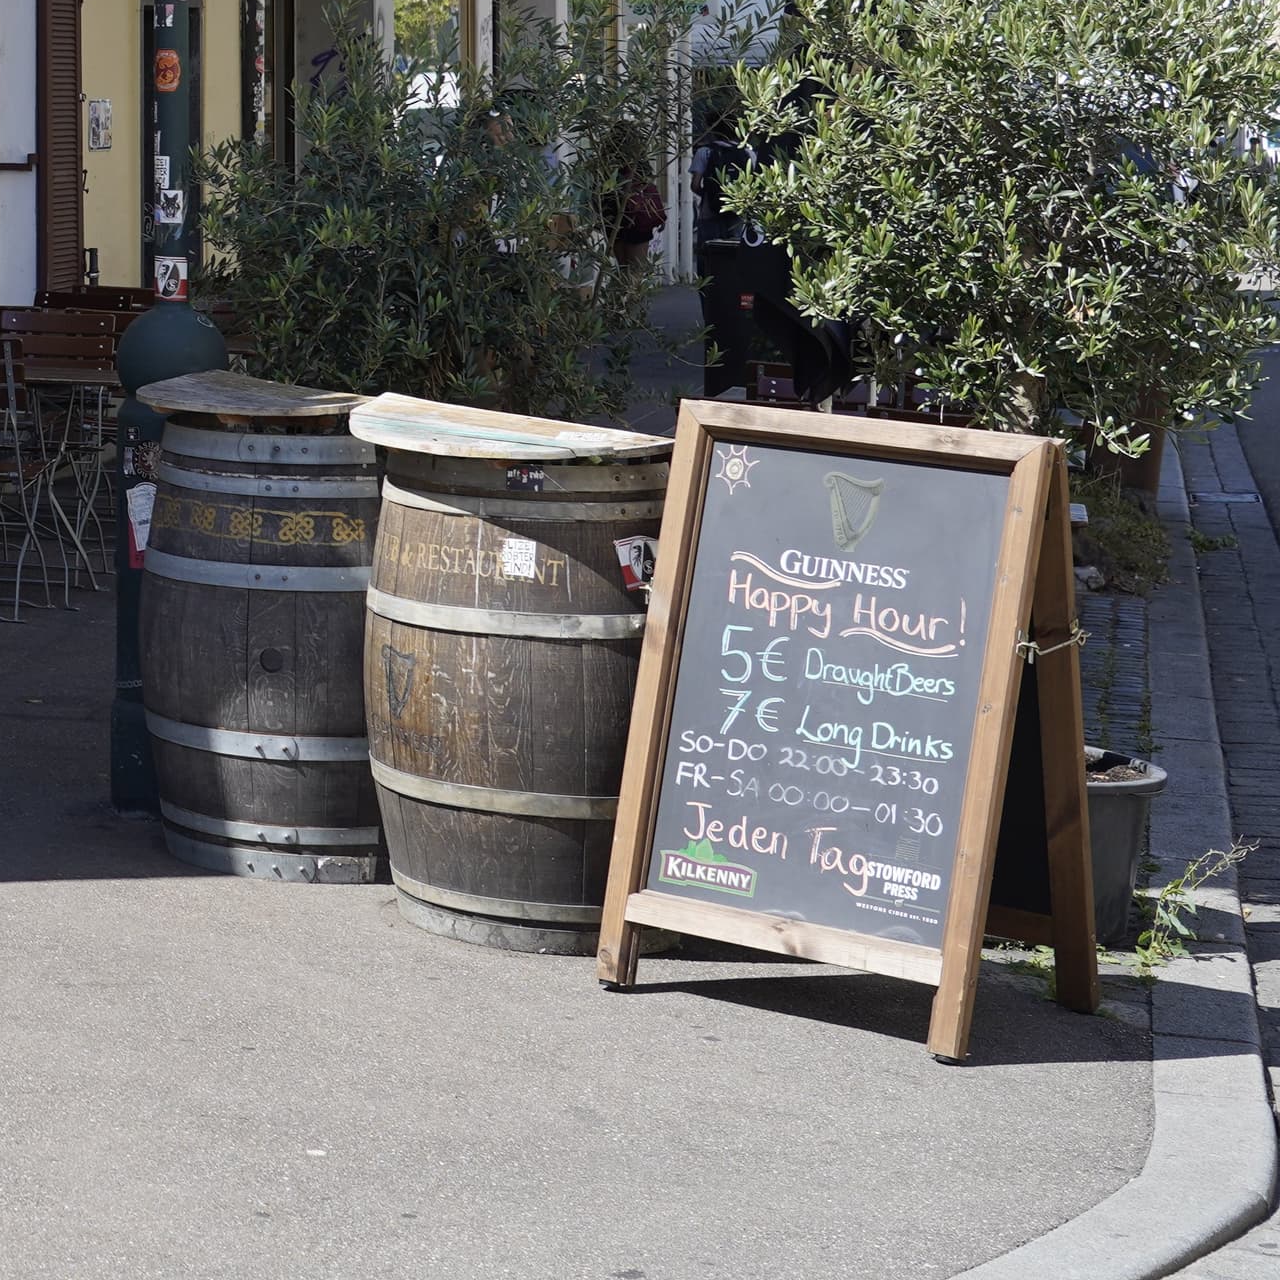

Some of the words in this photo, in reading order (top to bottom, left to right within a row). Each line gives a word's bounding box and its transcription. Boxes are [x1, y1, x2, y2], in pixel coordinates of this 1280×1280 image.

[416, 541, 564, 587] RESTAURNT
[780, 549, 909, 589] GUINNESS
[728, 569, 831, 639] Happy
[796, 705, 864, 769] Long
[871, 722, 954, 760] Drinks
[684, 802, 788, 859] Jeden
[804, 826, 869, 897] Tag
[666, 855, 752, 890] KILKENNY
[867, 861, 941, 891] STOWFORD
[883, 881, 919, 901] PRESS
